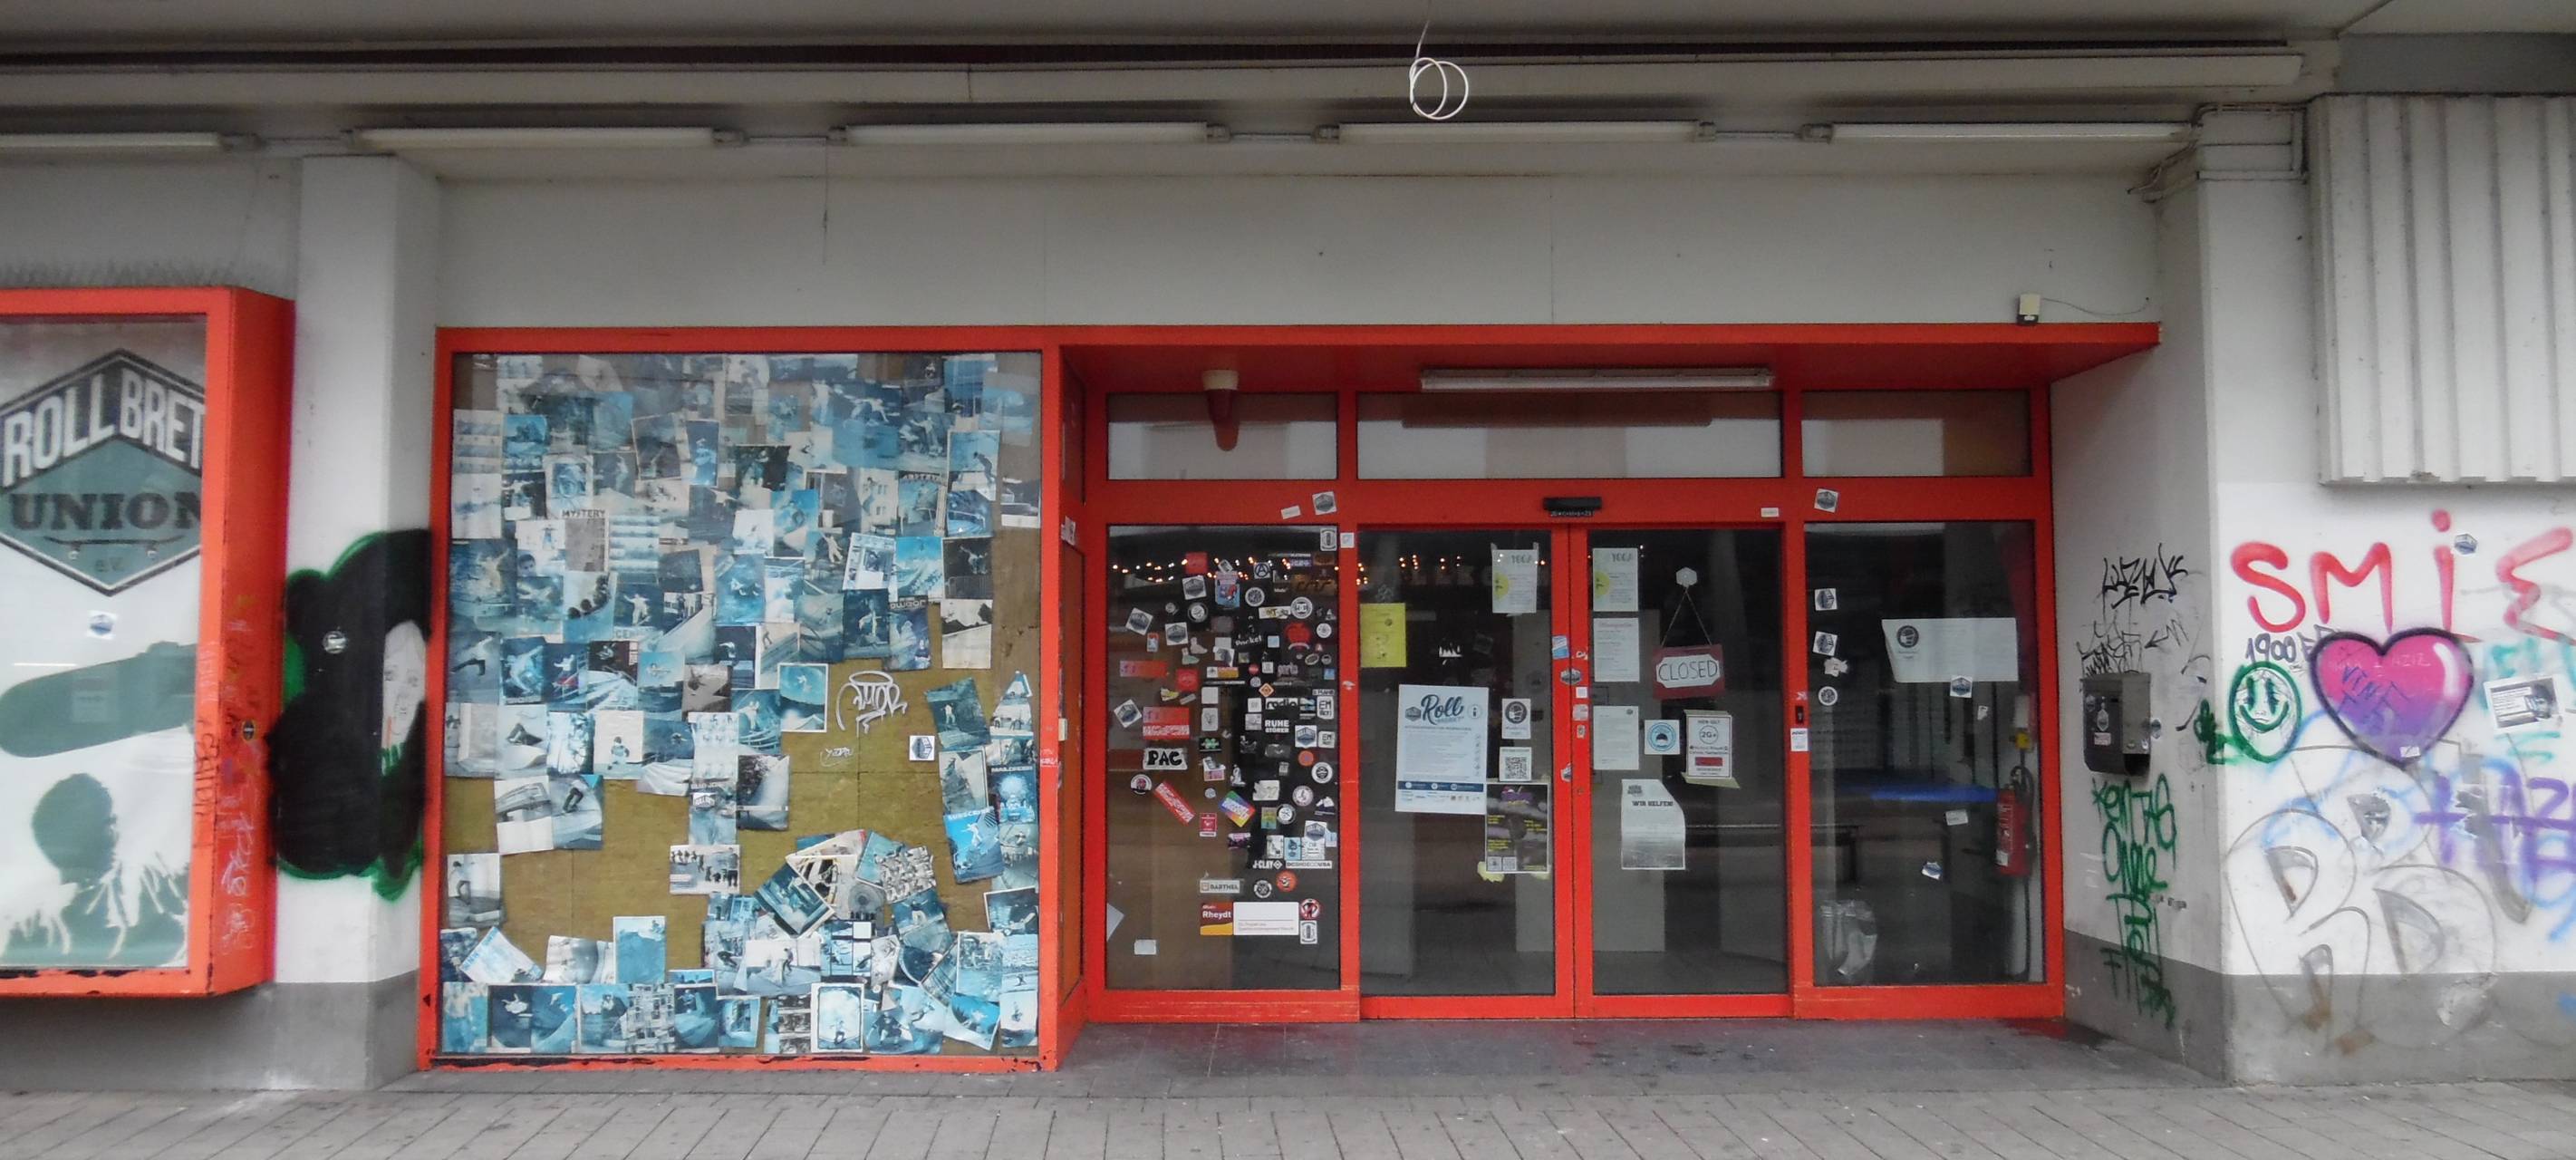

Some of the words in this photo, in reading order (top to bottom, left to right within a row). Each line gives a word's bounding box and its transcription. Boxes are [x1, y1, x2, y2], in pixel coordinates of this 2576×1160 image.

[562, 509, 605, 517] MYSTERY
[1658, 660, 1719, 681] CLOSED
[1420, 694, 1465, 726] Roll
[1265, 720, 1289, 728] RUHE
[1147, 750, 1182, 766] PAC
[1202, 910, 1231, 919] Rheydt
